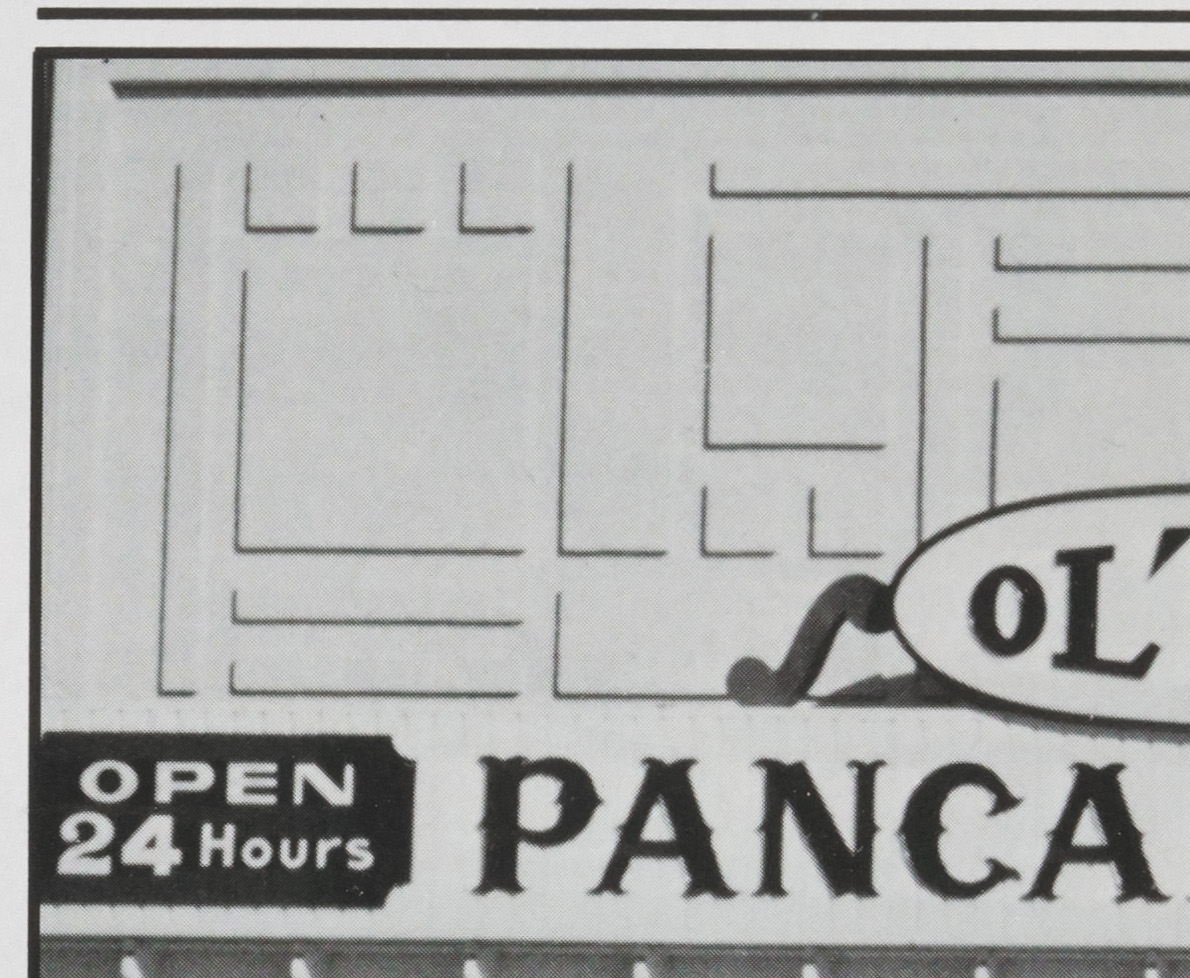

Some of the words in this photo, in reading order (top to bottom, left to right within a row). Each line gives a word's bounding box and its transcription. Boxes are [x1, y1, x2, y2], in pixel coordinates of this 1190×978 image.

[79, 758, 355, 806] OPEN
[57, 810, 183, 877] 24
[199, 821, 375, 872] Hours
